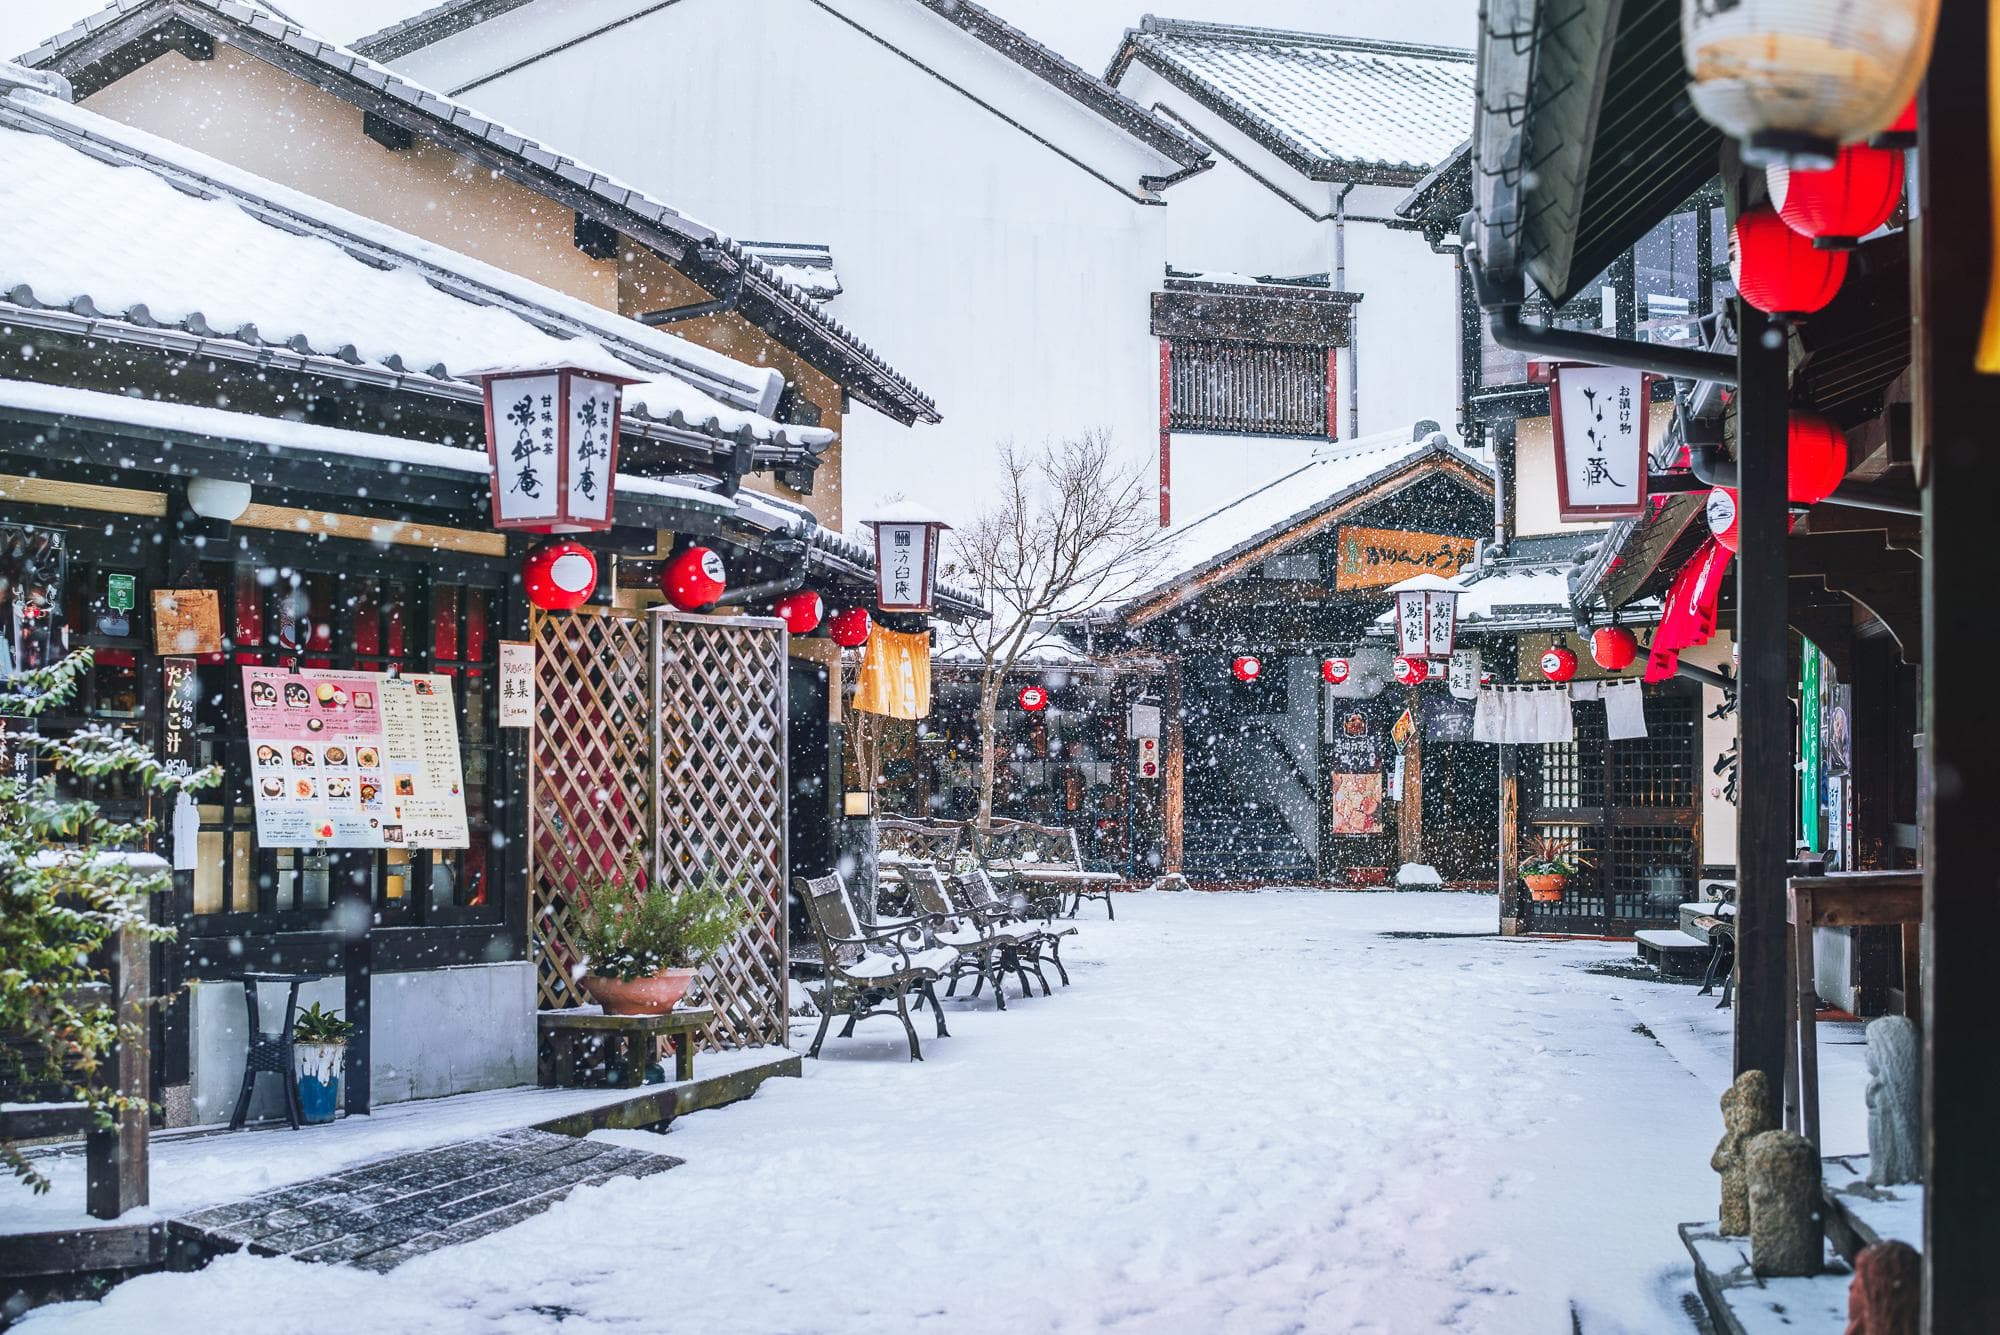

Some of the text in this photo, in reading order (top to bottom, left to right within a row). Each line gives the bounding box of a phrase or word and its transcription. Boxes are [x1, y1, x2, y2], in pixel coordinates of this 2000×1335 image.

[1618, 385, 1632, 435] お漬け物
[166, 666, 182, 753] だんご汁
[503, 678, 529, 699] 募集
